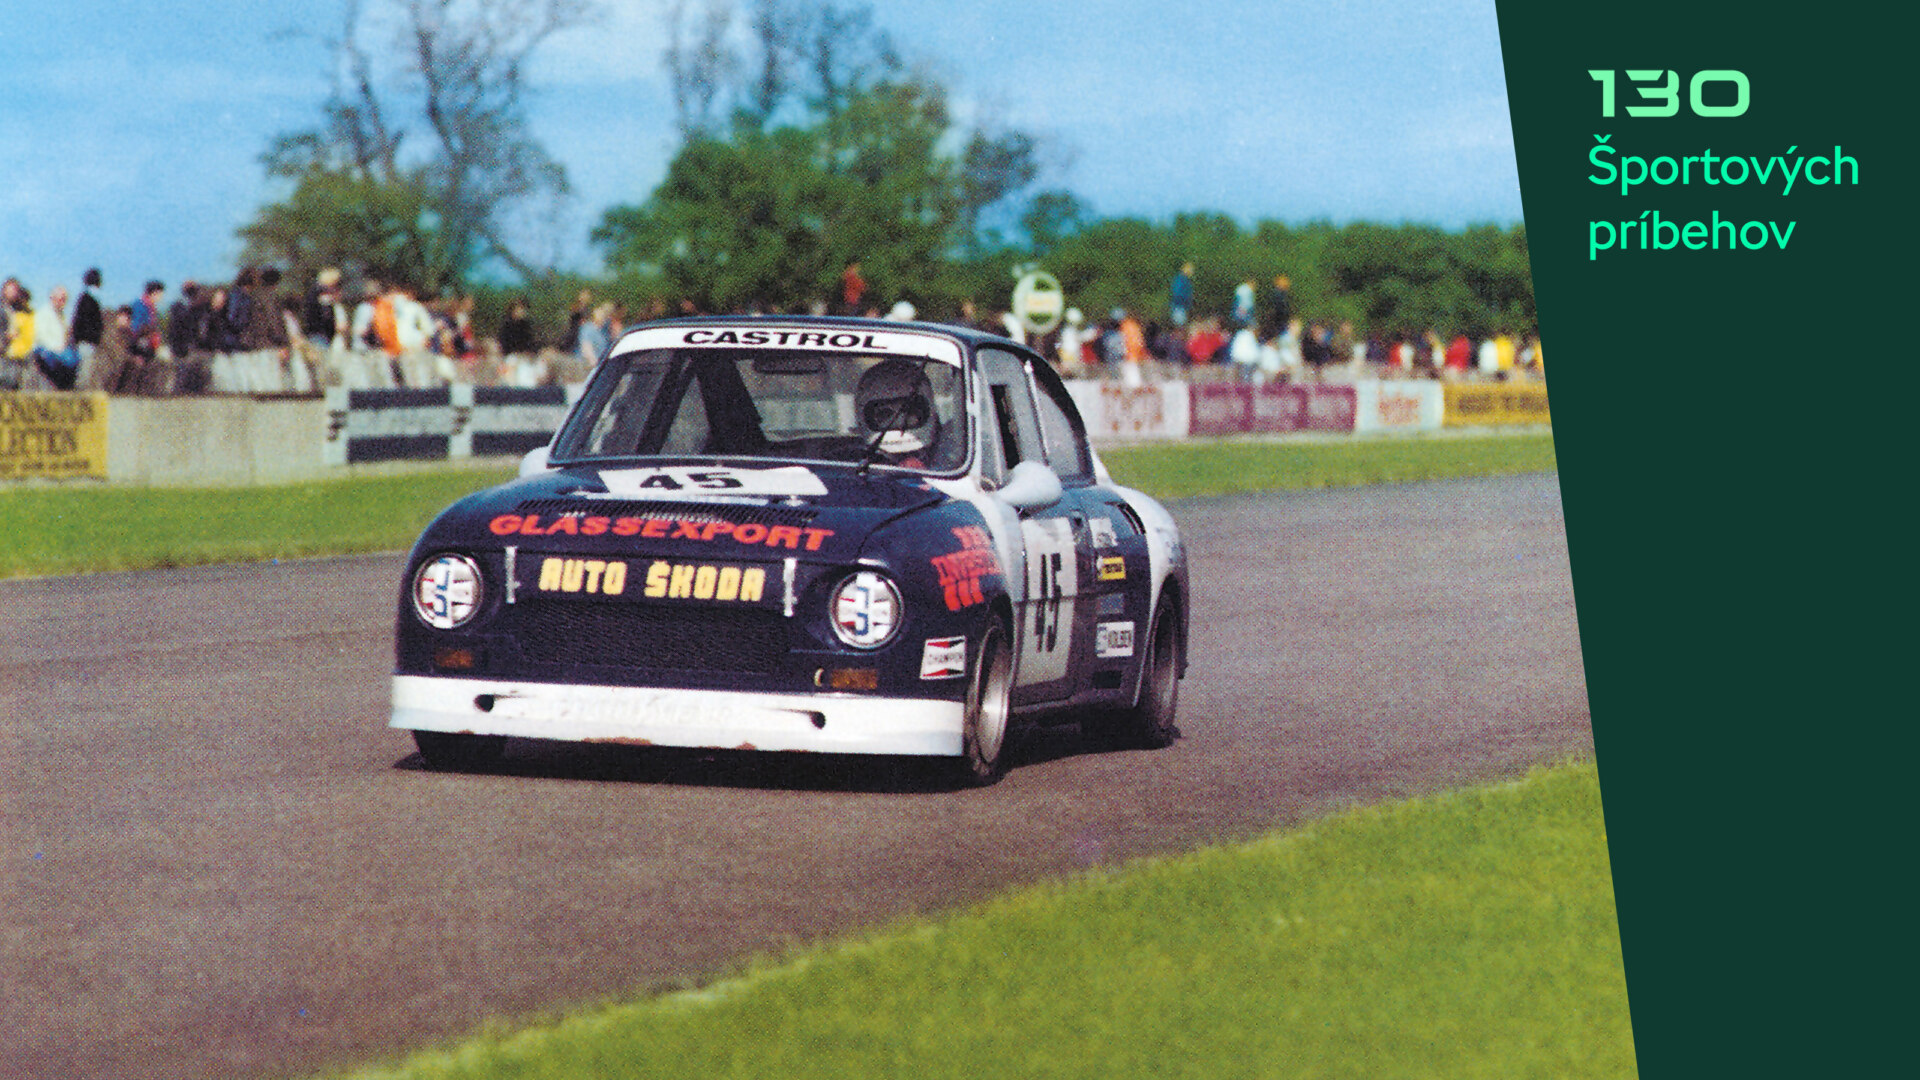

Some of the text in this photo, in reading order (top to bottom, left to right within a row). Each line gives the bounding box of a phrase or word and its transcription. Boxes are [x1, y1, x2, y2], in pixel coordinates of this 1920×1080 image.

[682, 330, 888, 350] CASTROL
[639, 471, 744, 491] 45
[488, 514, 836, 551] GLASSEXPORT
[538, 557, 628, 596] AUTO
[644, 559, 767, 602] ŠKODA
[1034, 552, 1063, 653] 45
